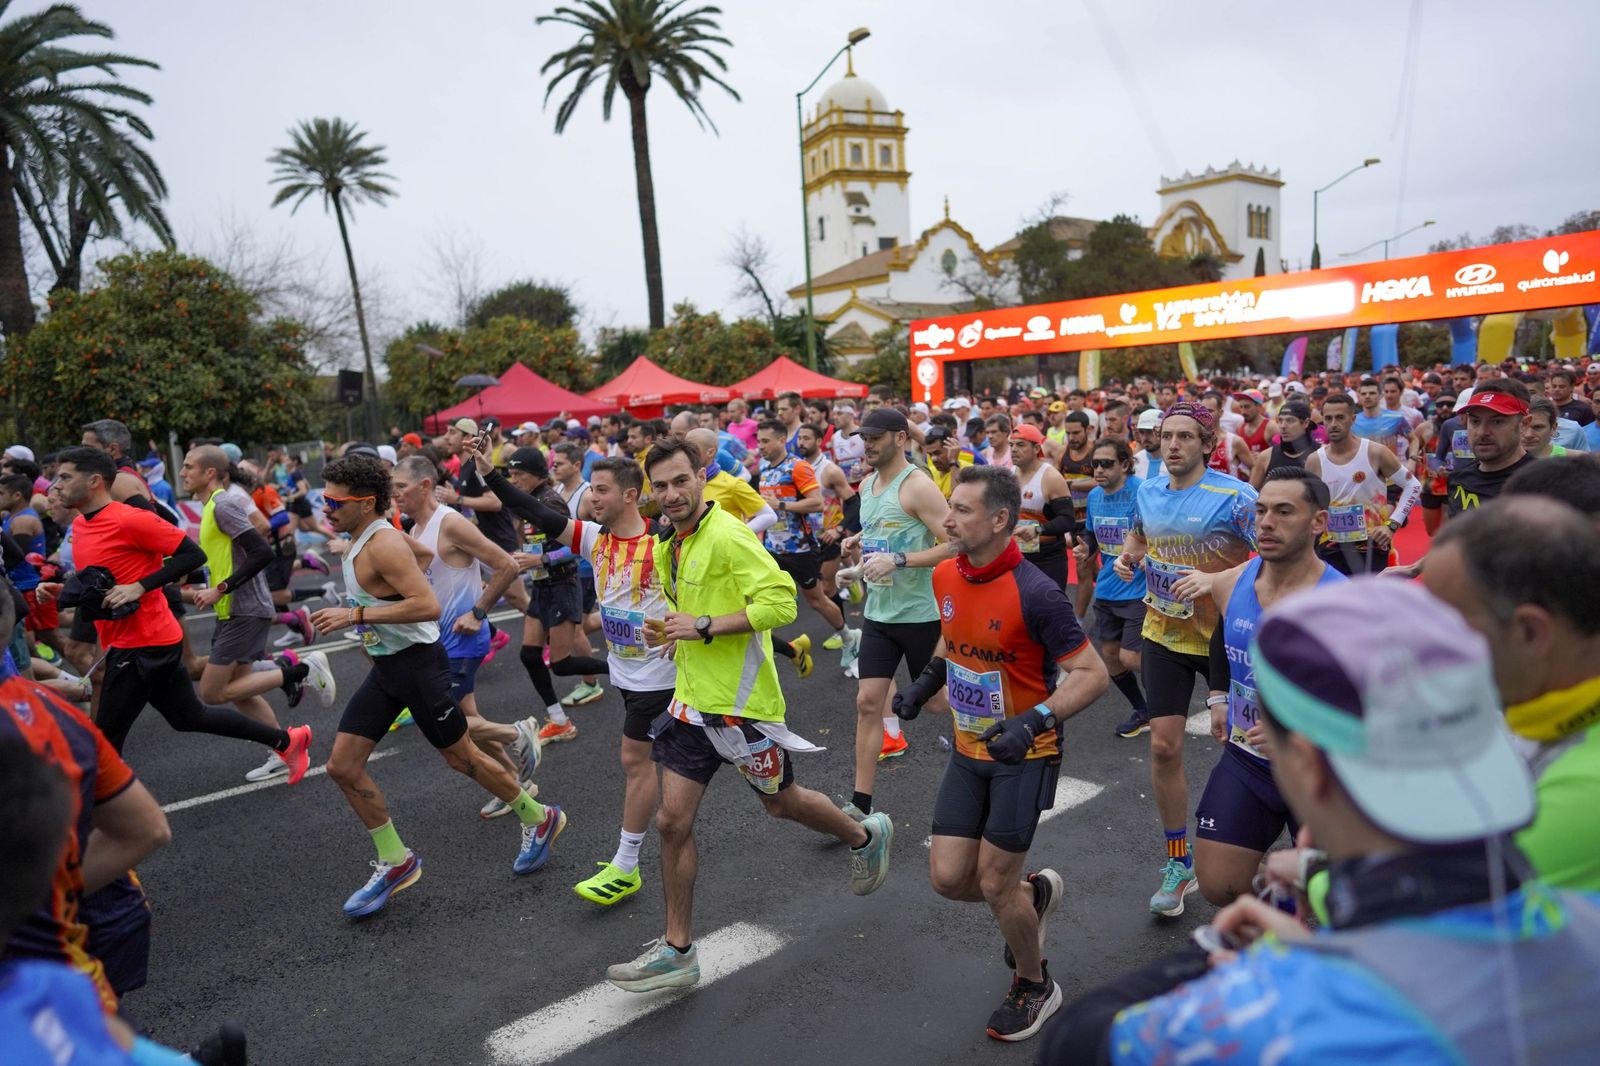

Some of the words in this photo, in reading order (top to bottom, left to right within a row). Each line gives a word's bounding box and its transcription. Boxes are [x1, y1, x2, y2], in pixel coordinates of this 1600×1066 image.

[1361, 276, 1433, 304] HOKA
[1446, 282, 1504, 299] HYUNDAI
[1099, 527, 1120, 539] 3274
[1150, 571, 1177, 592] 174
[605, 618, 630, 639] 3300
[959, 643, 1018, 663] CAMAS
[952, 679, 985, 708] 2622
[751, 752, 773, 772] 64
